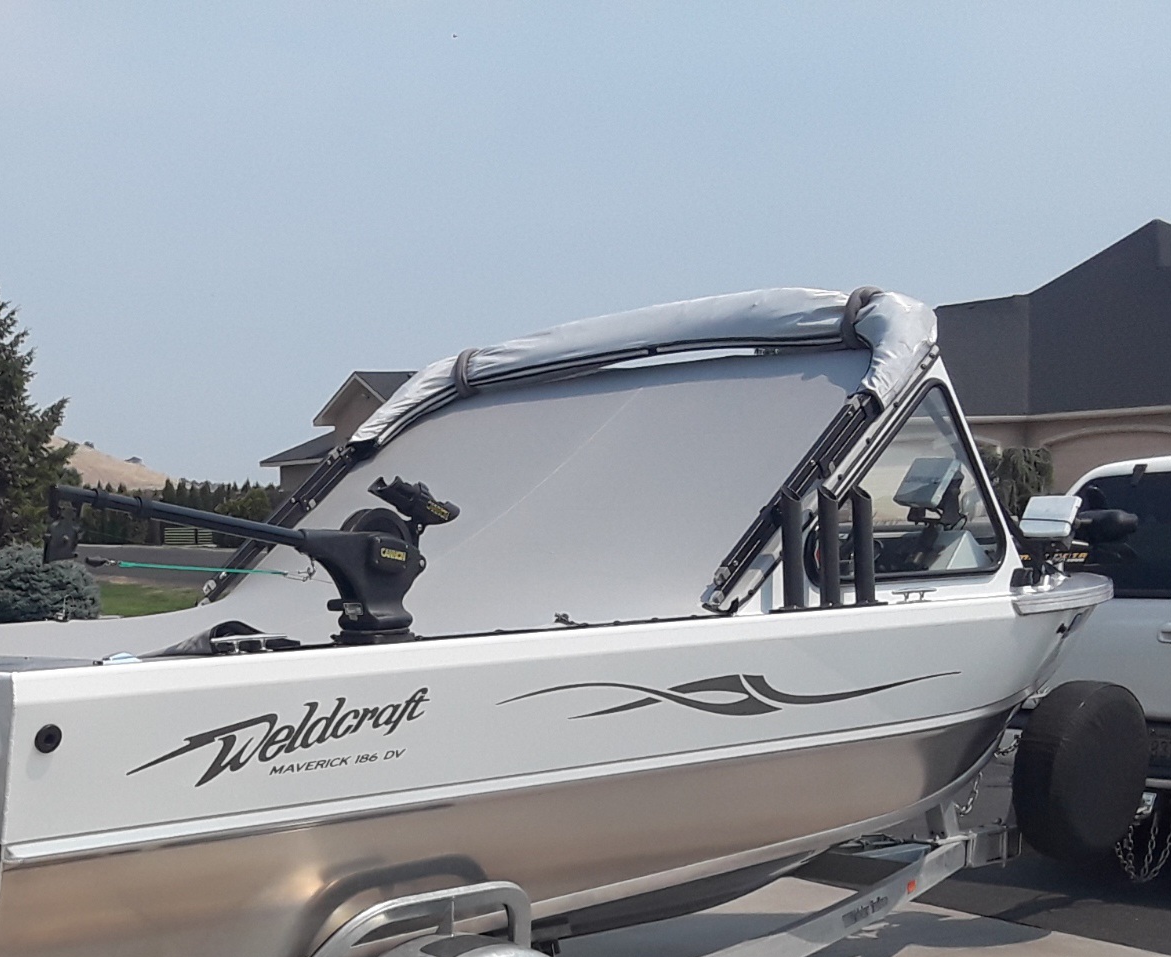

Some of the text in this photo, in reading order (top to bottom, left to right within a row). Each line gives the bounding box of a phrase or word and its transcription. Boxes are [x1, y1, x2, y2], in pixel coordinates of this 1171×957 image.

[126, 687, 430, 788] Weldcraft
[269, 748, 407, 776] MAVERICK 186 DV
